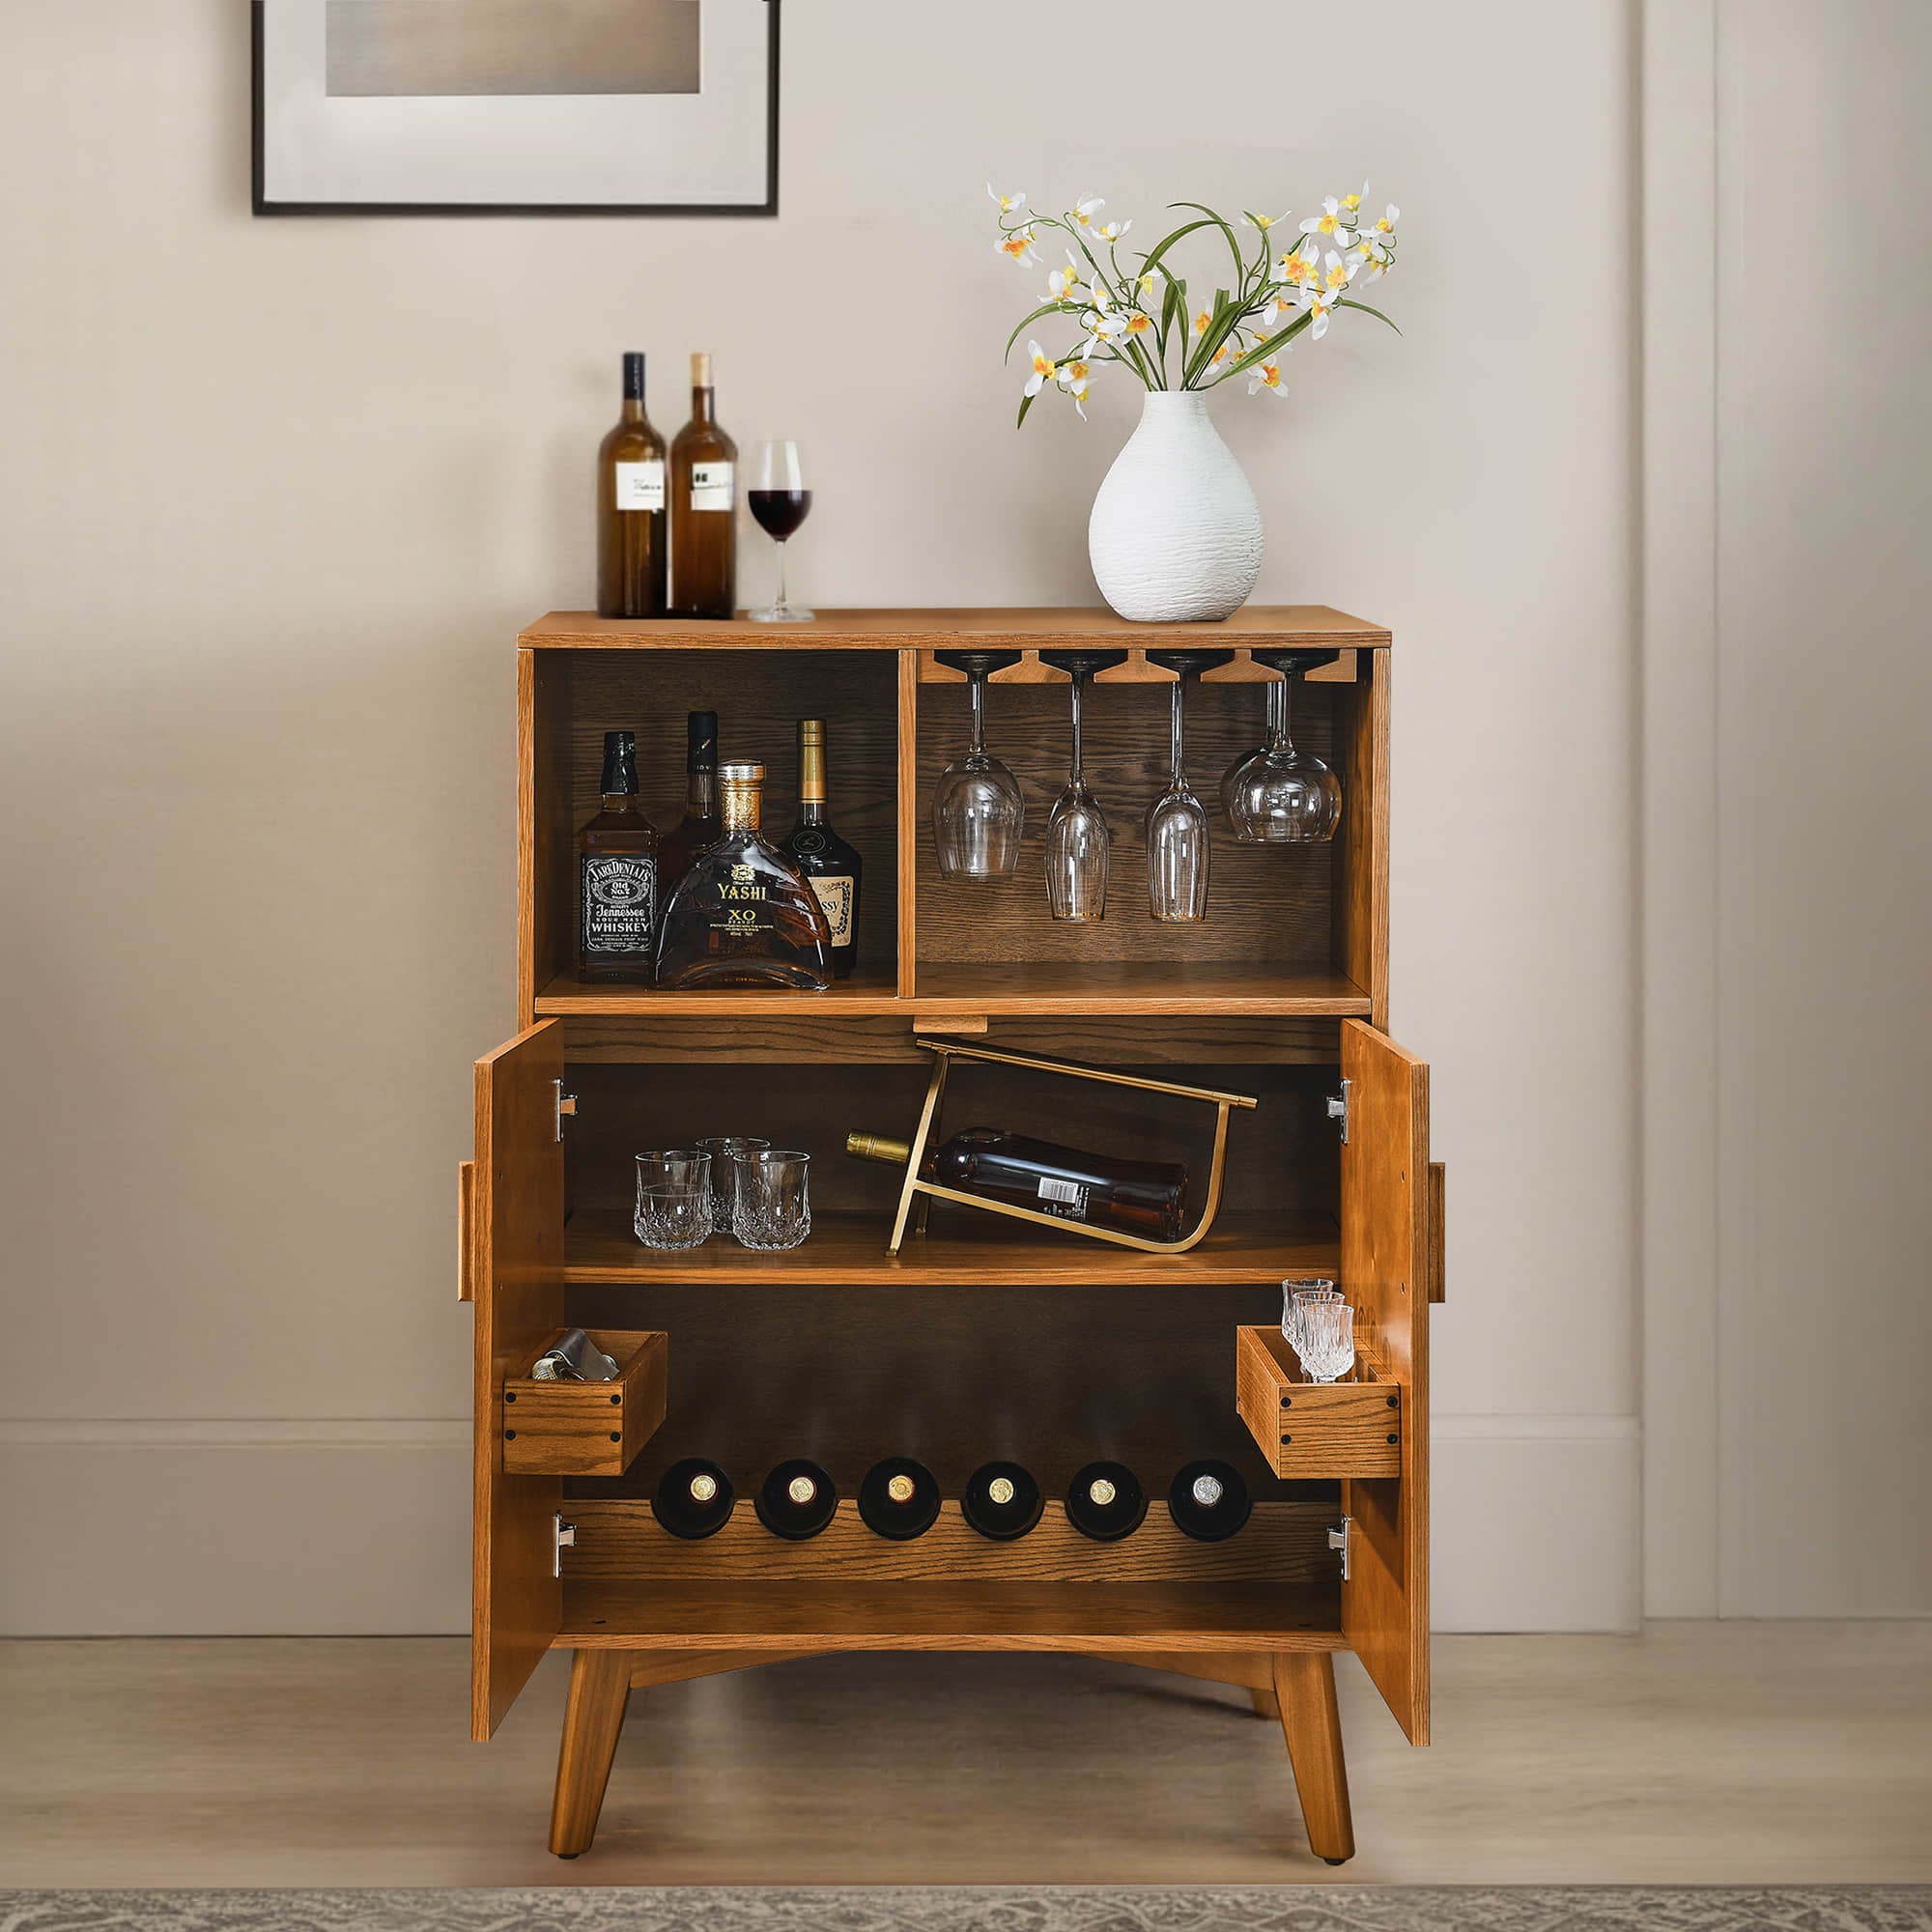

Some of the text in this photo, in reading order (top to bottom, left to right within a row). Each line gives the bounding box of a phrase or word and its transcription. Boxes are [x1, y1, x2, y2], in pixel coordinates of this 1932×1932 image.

[718, 883, 766, 899] YASHI
[728, 909, 756, 921] XO
[591, 923, 649, 932] WHISKEY
